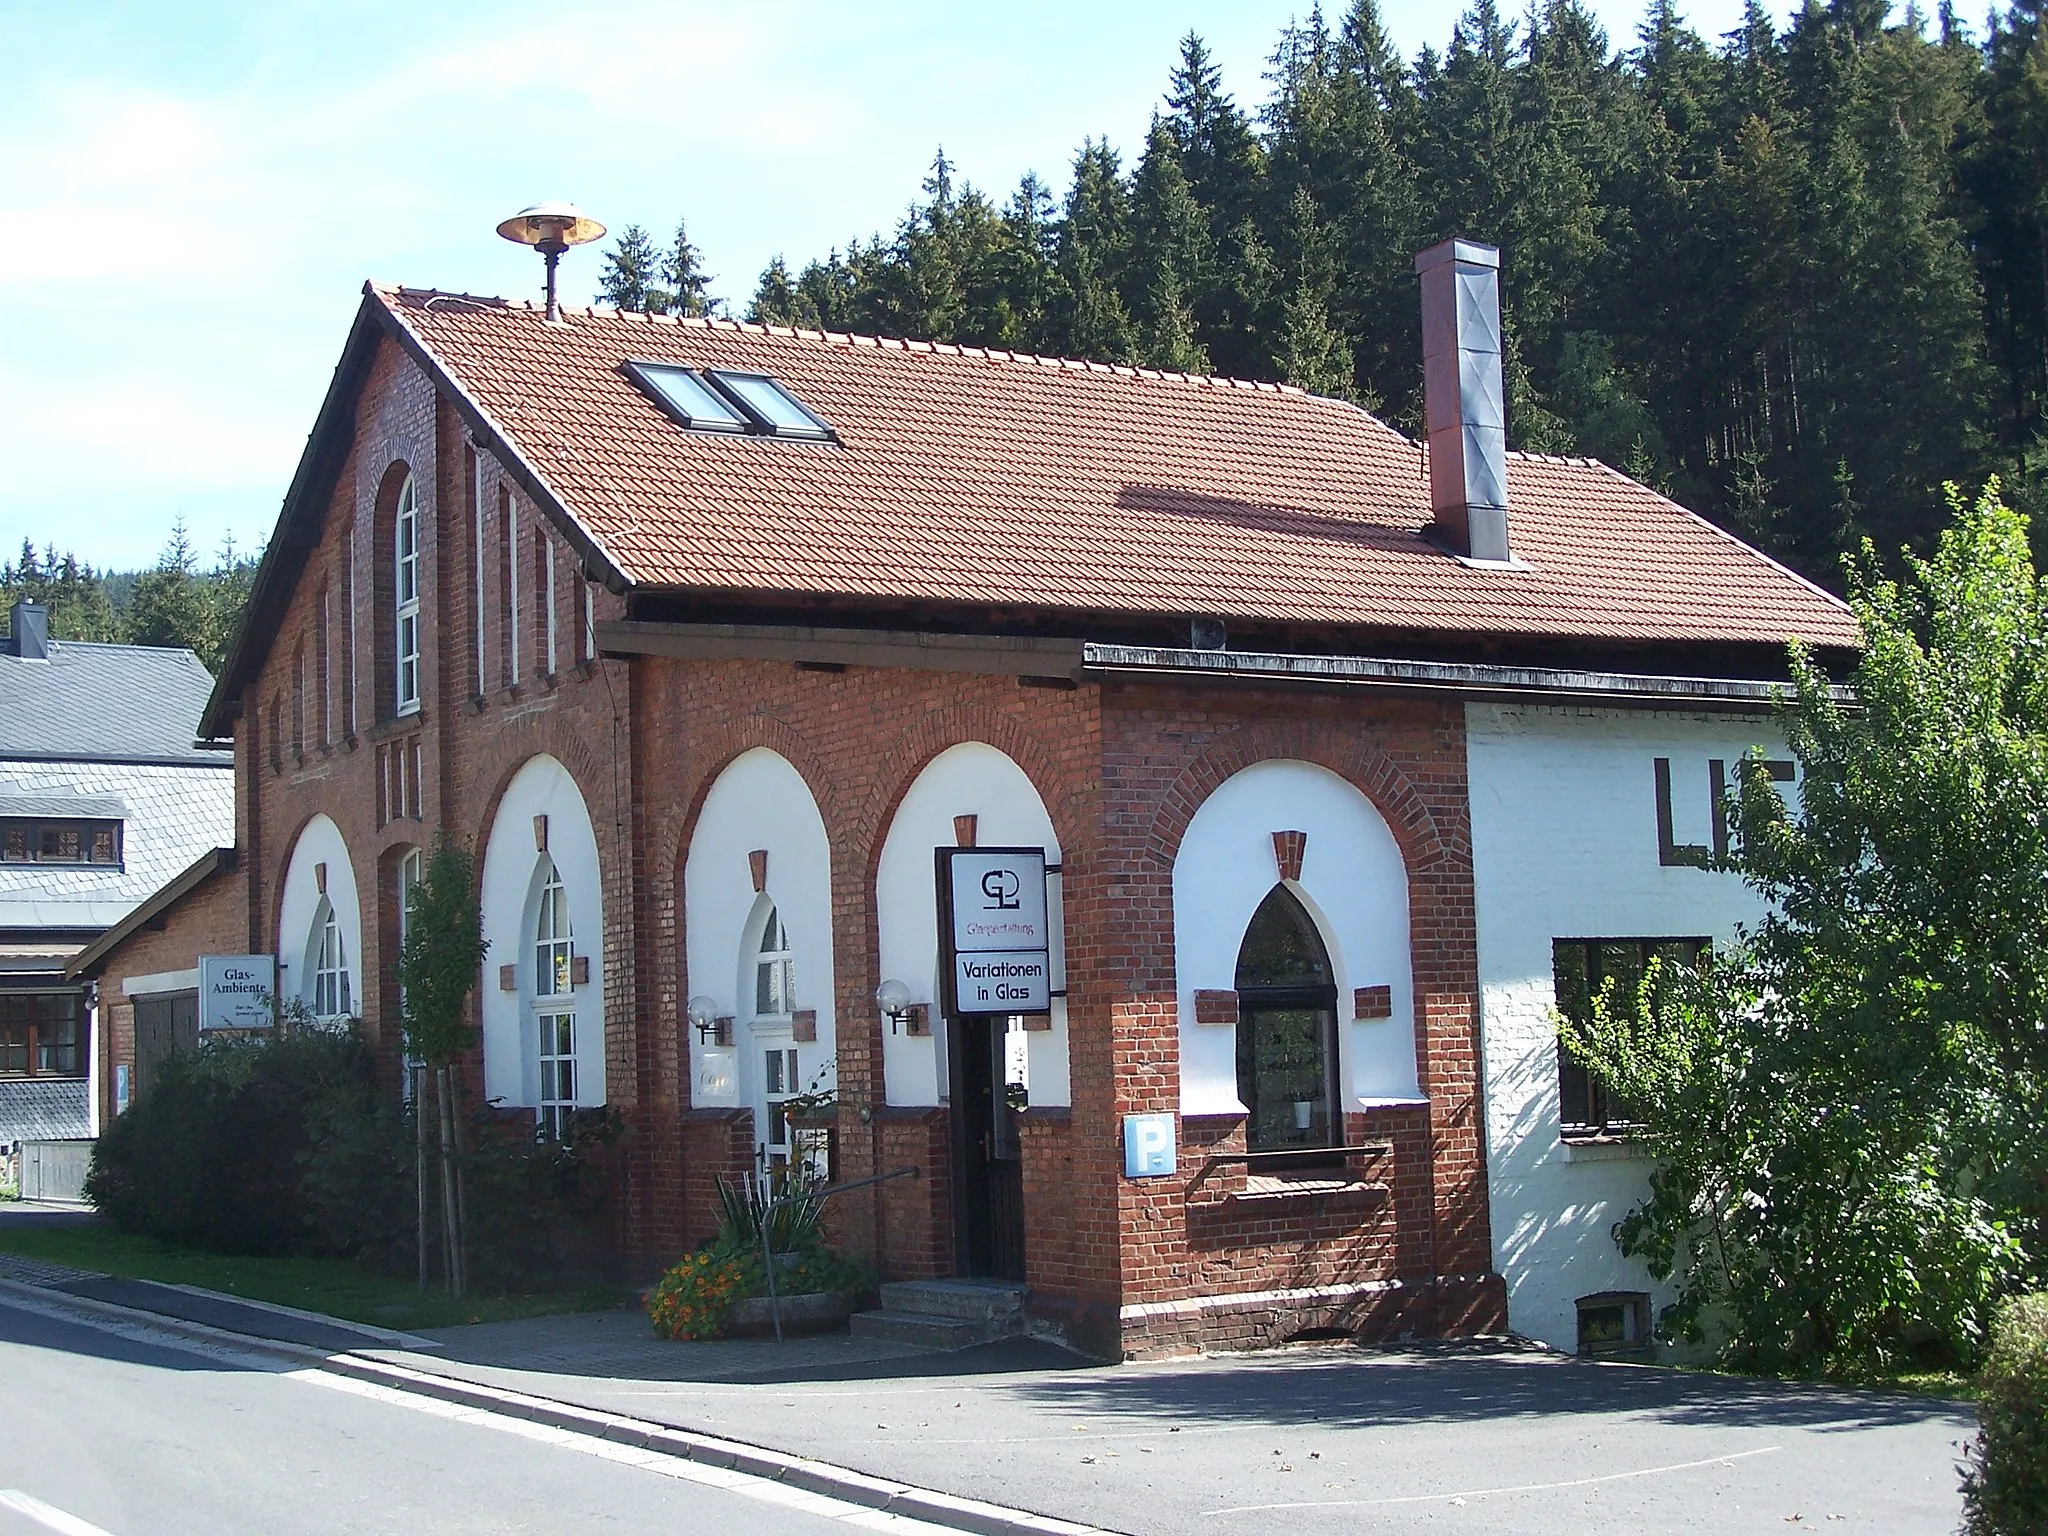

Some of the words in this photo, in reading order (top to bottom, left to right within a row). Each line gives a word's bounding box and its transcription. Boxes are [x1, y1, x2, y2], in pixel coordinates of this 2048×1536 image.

[224, 968, 255, 980] Glas-
[962, 961, 1042, 978] Variationen
[212, 982, 267, 994] Ambiente
[977, 985, 989, 1000] in
[995, 982, 1030, 1000] Glas
[1135, 1120, 1168, 1172] P
